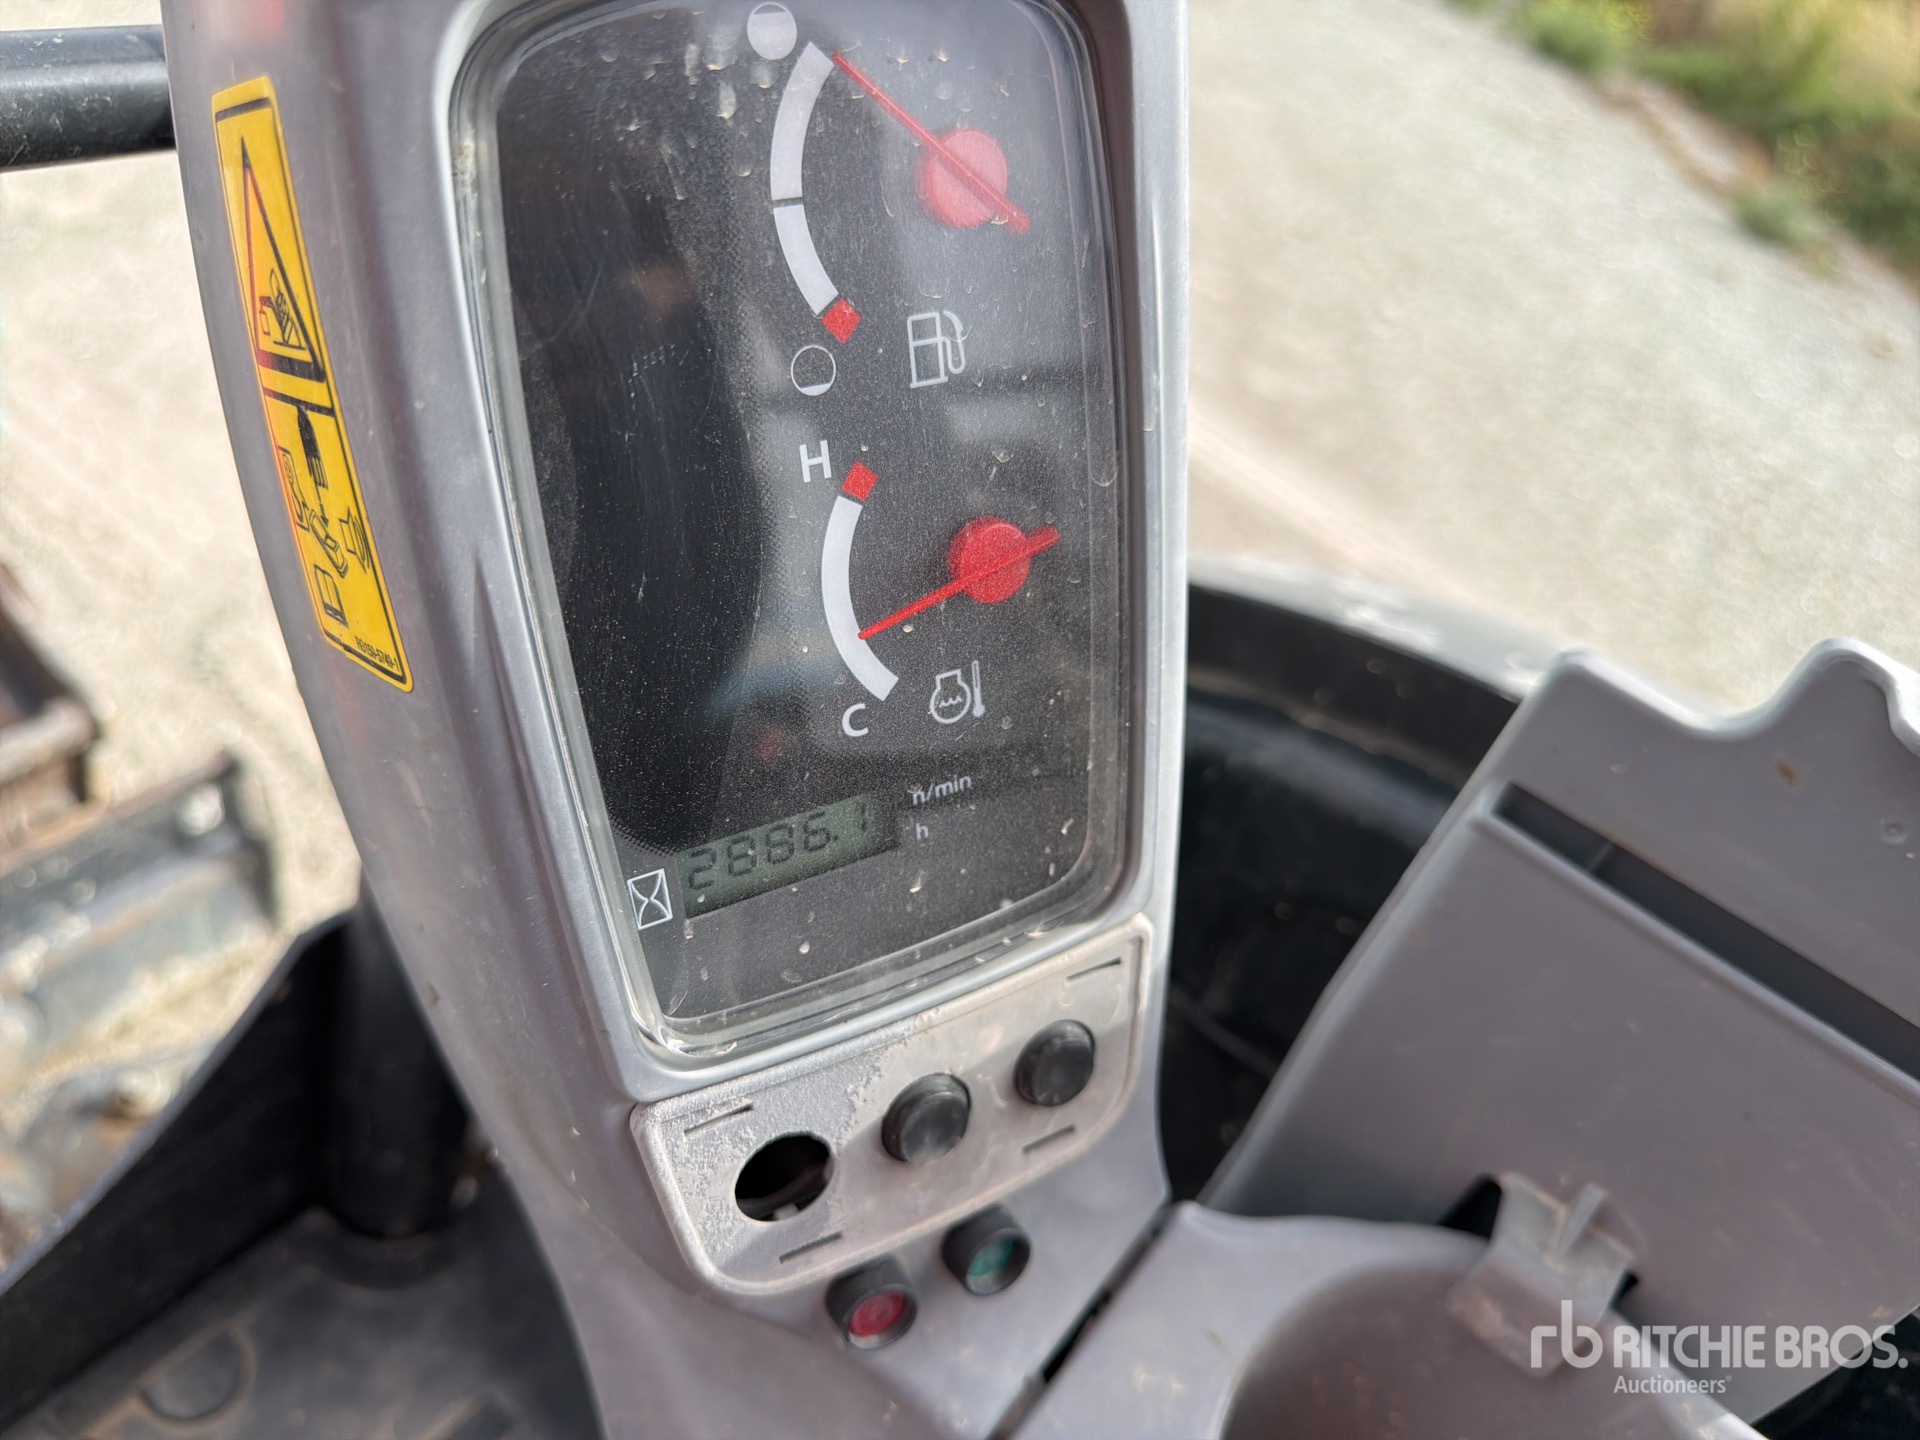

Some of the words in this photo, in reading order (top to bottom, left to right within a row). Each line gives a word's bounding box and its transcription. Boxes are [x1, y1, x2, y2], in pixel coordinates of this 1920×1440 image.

[799, 439, 832, 483] H
[841, 702, 869, 737] C
[912, 774, 972, 805] n/min
[915, 822, 929, 840] h
